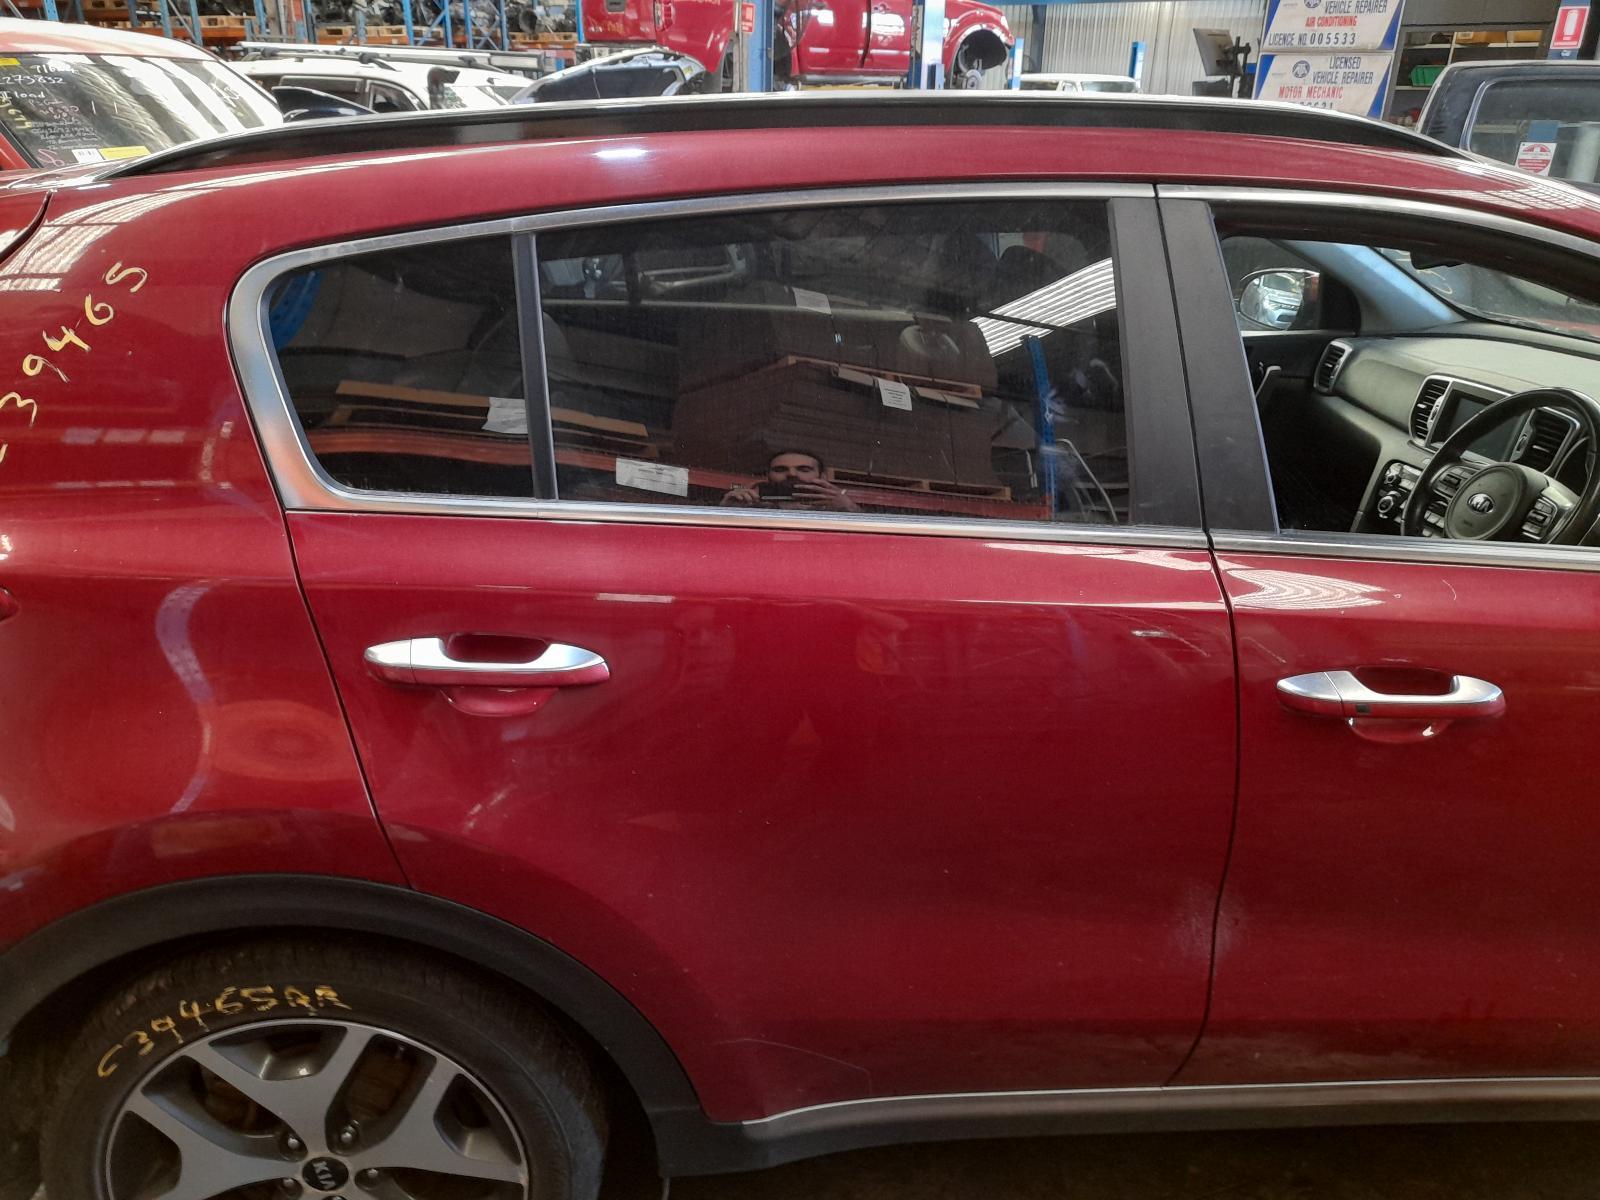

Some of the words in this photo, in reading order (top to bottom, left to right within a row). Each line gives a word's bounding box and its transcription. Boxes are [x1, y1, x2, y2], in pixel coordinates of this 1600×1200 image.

[1324, 0, 1352, 14] VEHICLE
[1354, 0, 1387, 14] REPAIRER
[1305, 16, 1316, 27] AIR
[1317, 16, 1357, 27] CONDITIONING
[1268, 32, 1295, 46] LICENCE
[1310, 32, 1356, 45] 005533
[1329, 57, 1361, 70] LICENSED
[1312, 71, 1339, 85] VEHICLE
[1341, 71, 1374, 85] REPAIRER
[1278, 86, 1303, 99] MOTOR
[1306, 86, 1344, 99] MECHANIC
[312, 1160, 337, 1190] KIA
